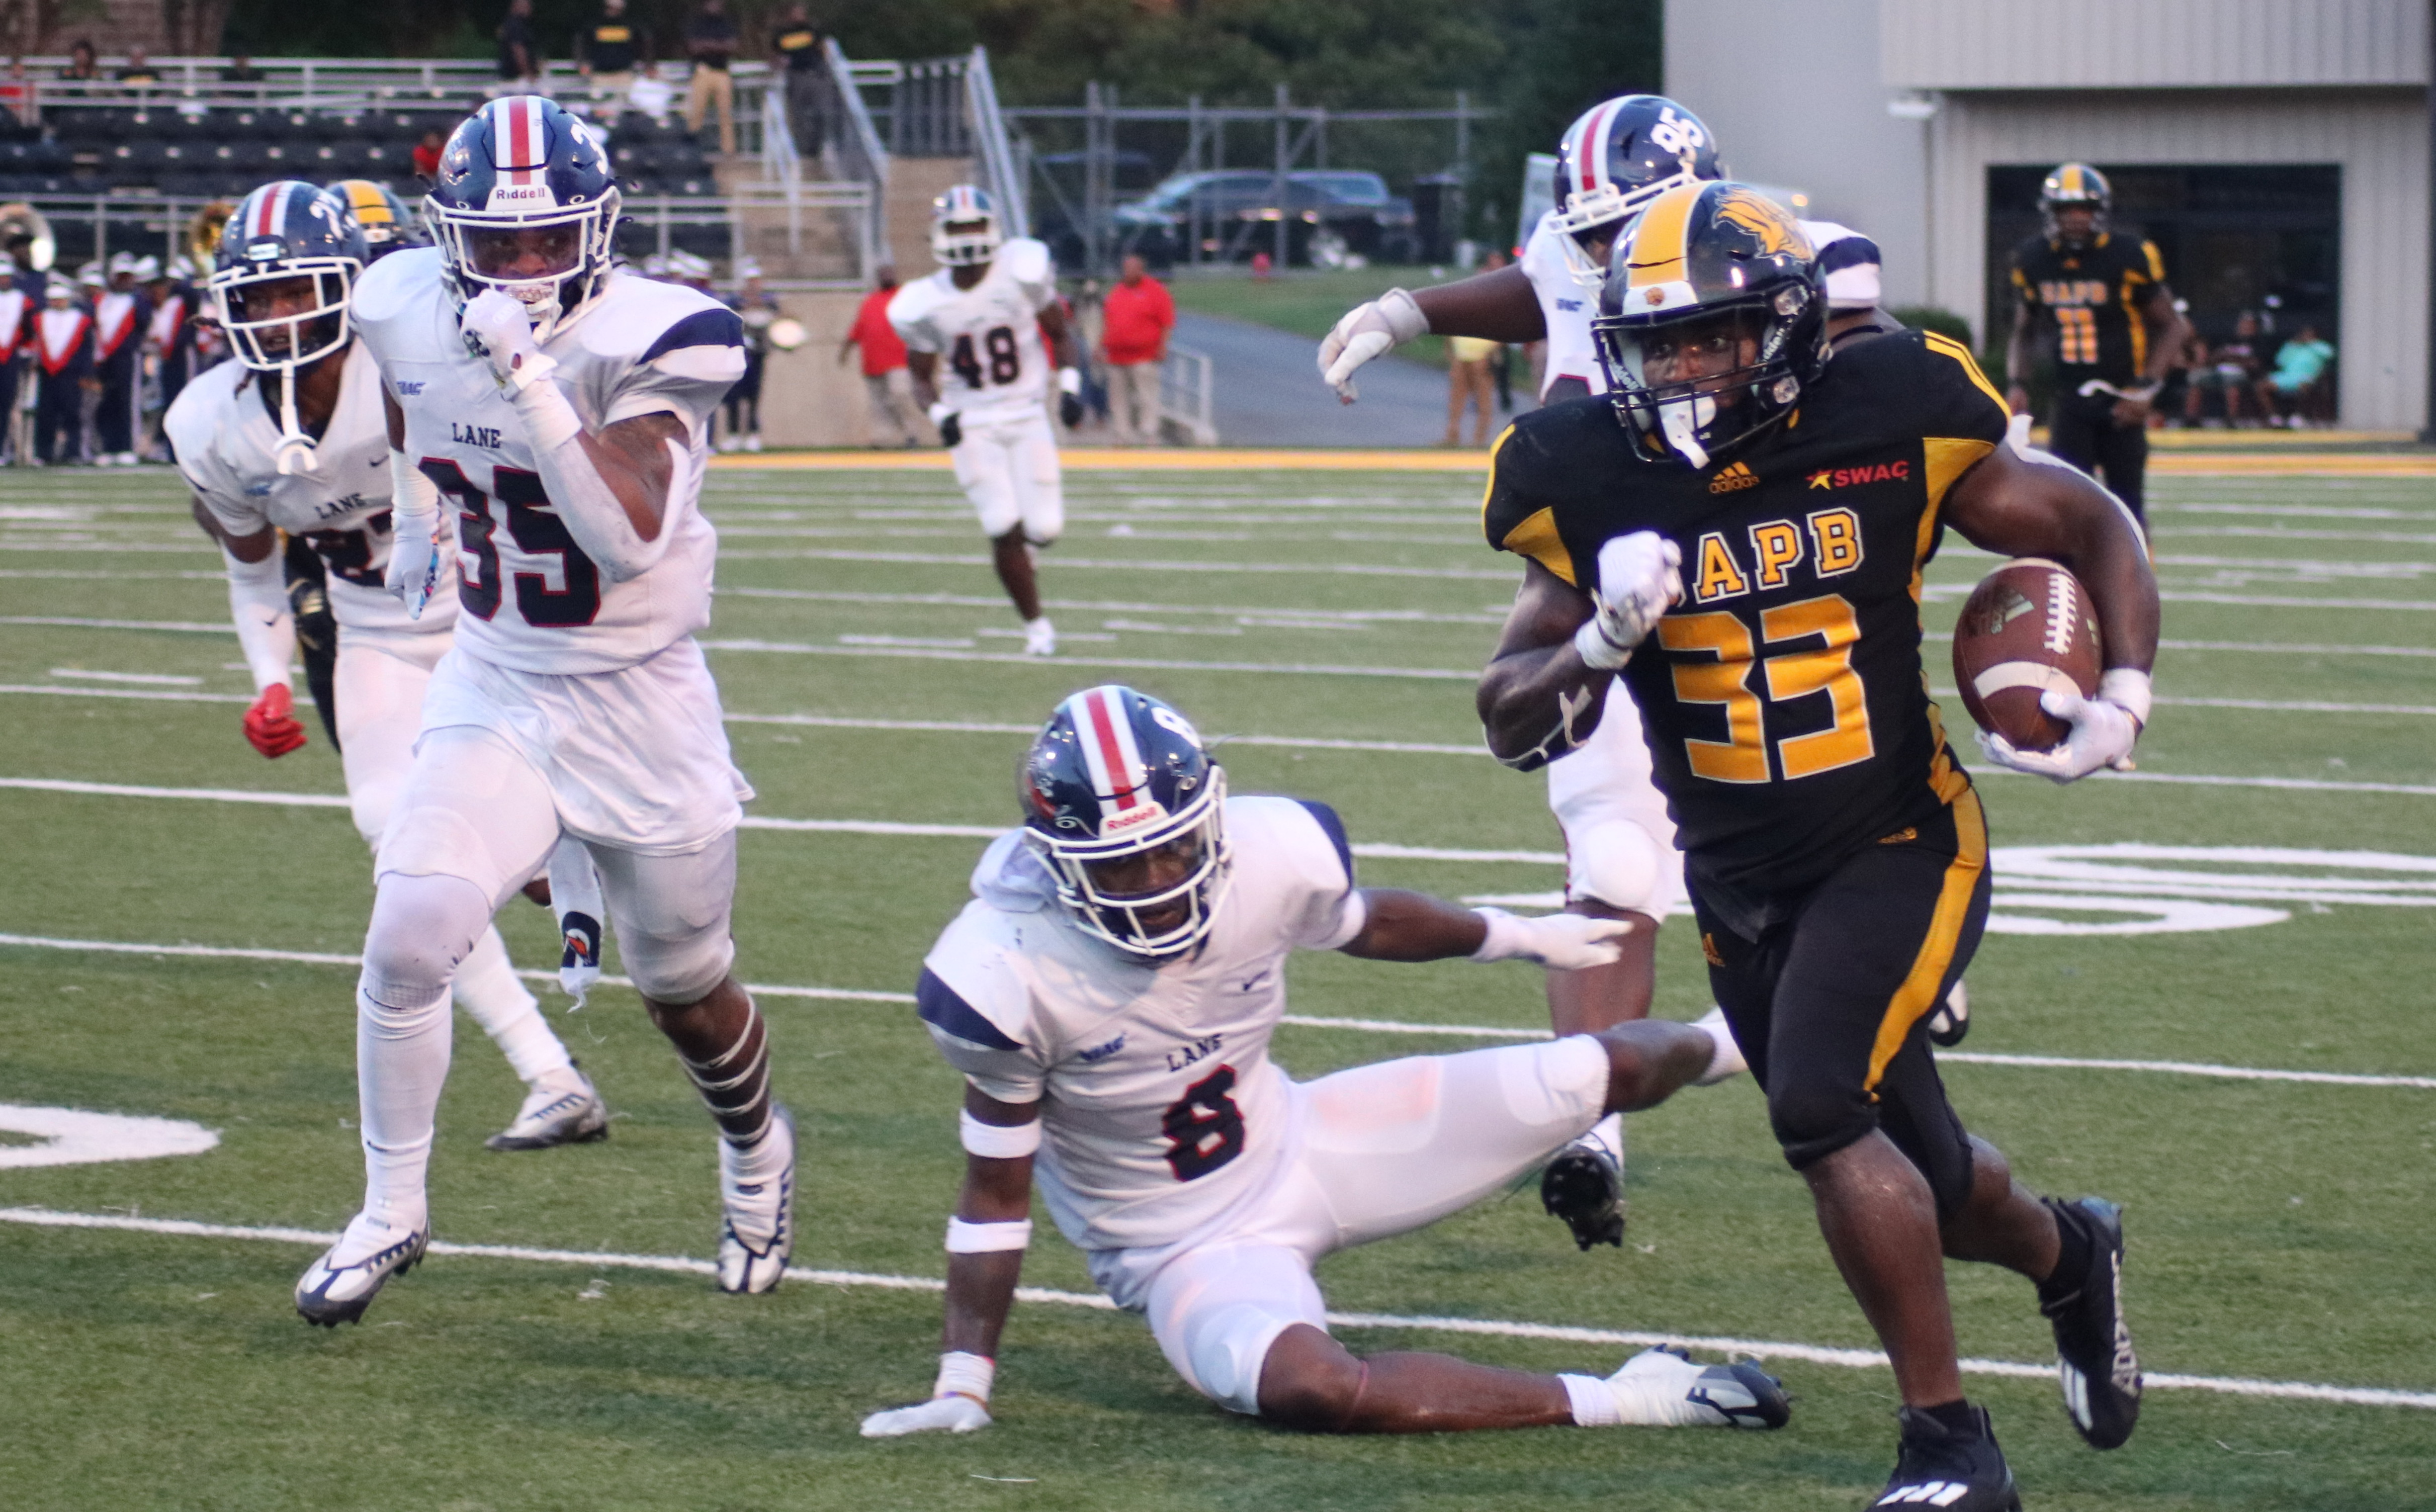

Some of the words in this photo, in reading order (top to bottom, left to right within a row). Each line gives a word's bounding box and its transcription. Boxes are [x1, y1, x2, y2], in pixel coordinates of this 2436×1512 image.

[570, 116, 610, 175] 3
[496, 188, 545, 200] Riddell
[951, 323, 1020, 390] 48
[2055, 307, 2099, 364] 11
[452, 422, 502, 448] LANE
[1709, 474, 1760, 494] adidas
[1834, 460, 1910, 488] SWAC
[314, 493, 367, 519] LANE
[418, 456, 601, 628] 35
[1678, 507, 1865, 604] APB
[1656, 593, 1875, 785] 33
[1150, 706, 1203, 750] 8
[1167, 1033, 1224, 1072] LANE
[1162, 1063, 1246, 1182] 8
